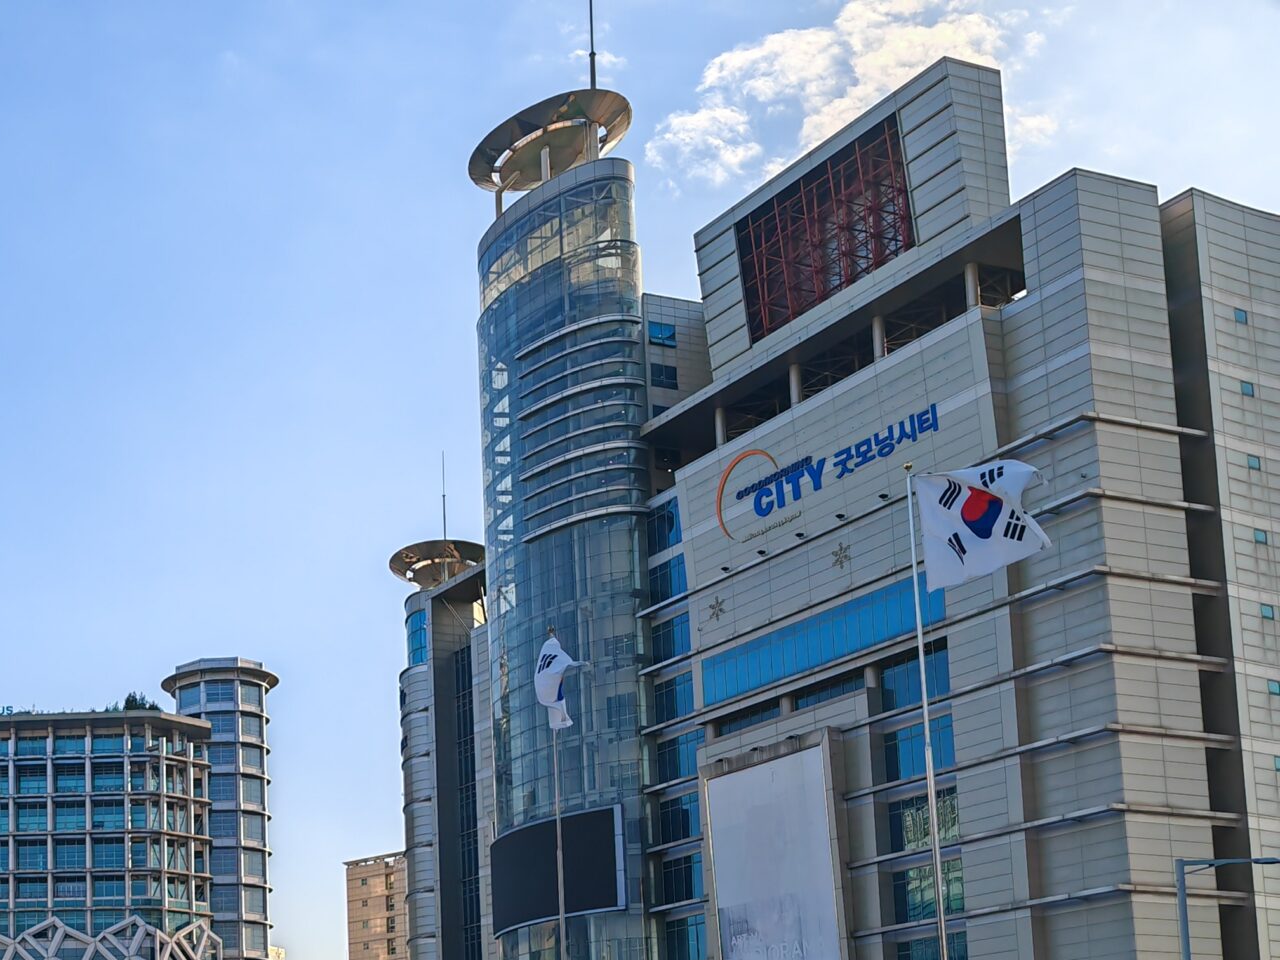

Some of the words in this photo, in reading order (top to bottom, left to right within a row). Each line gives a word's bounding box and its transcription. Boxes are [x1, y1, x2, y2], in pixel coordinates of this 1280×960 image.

[833, 403, 939, 480] 굿모닝시티
[736, 456, 813, 500] GOODMORNING
[754, 457, 827, 517] CITY
